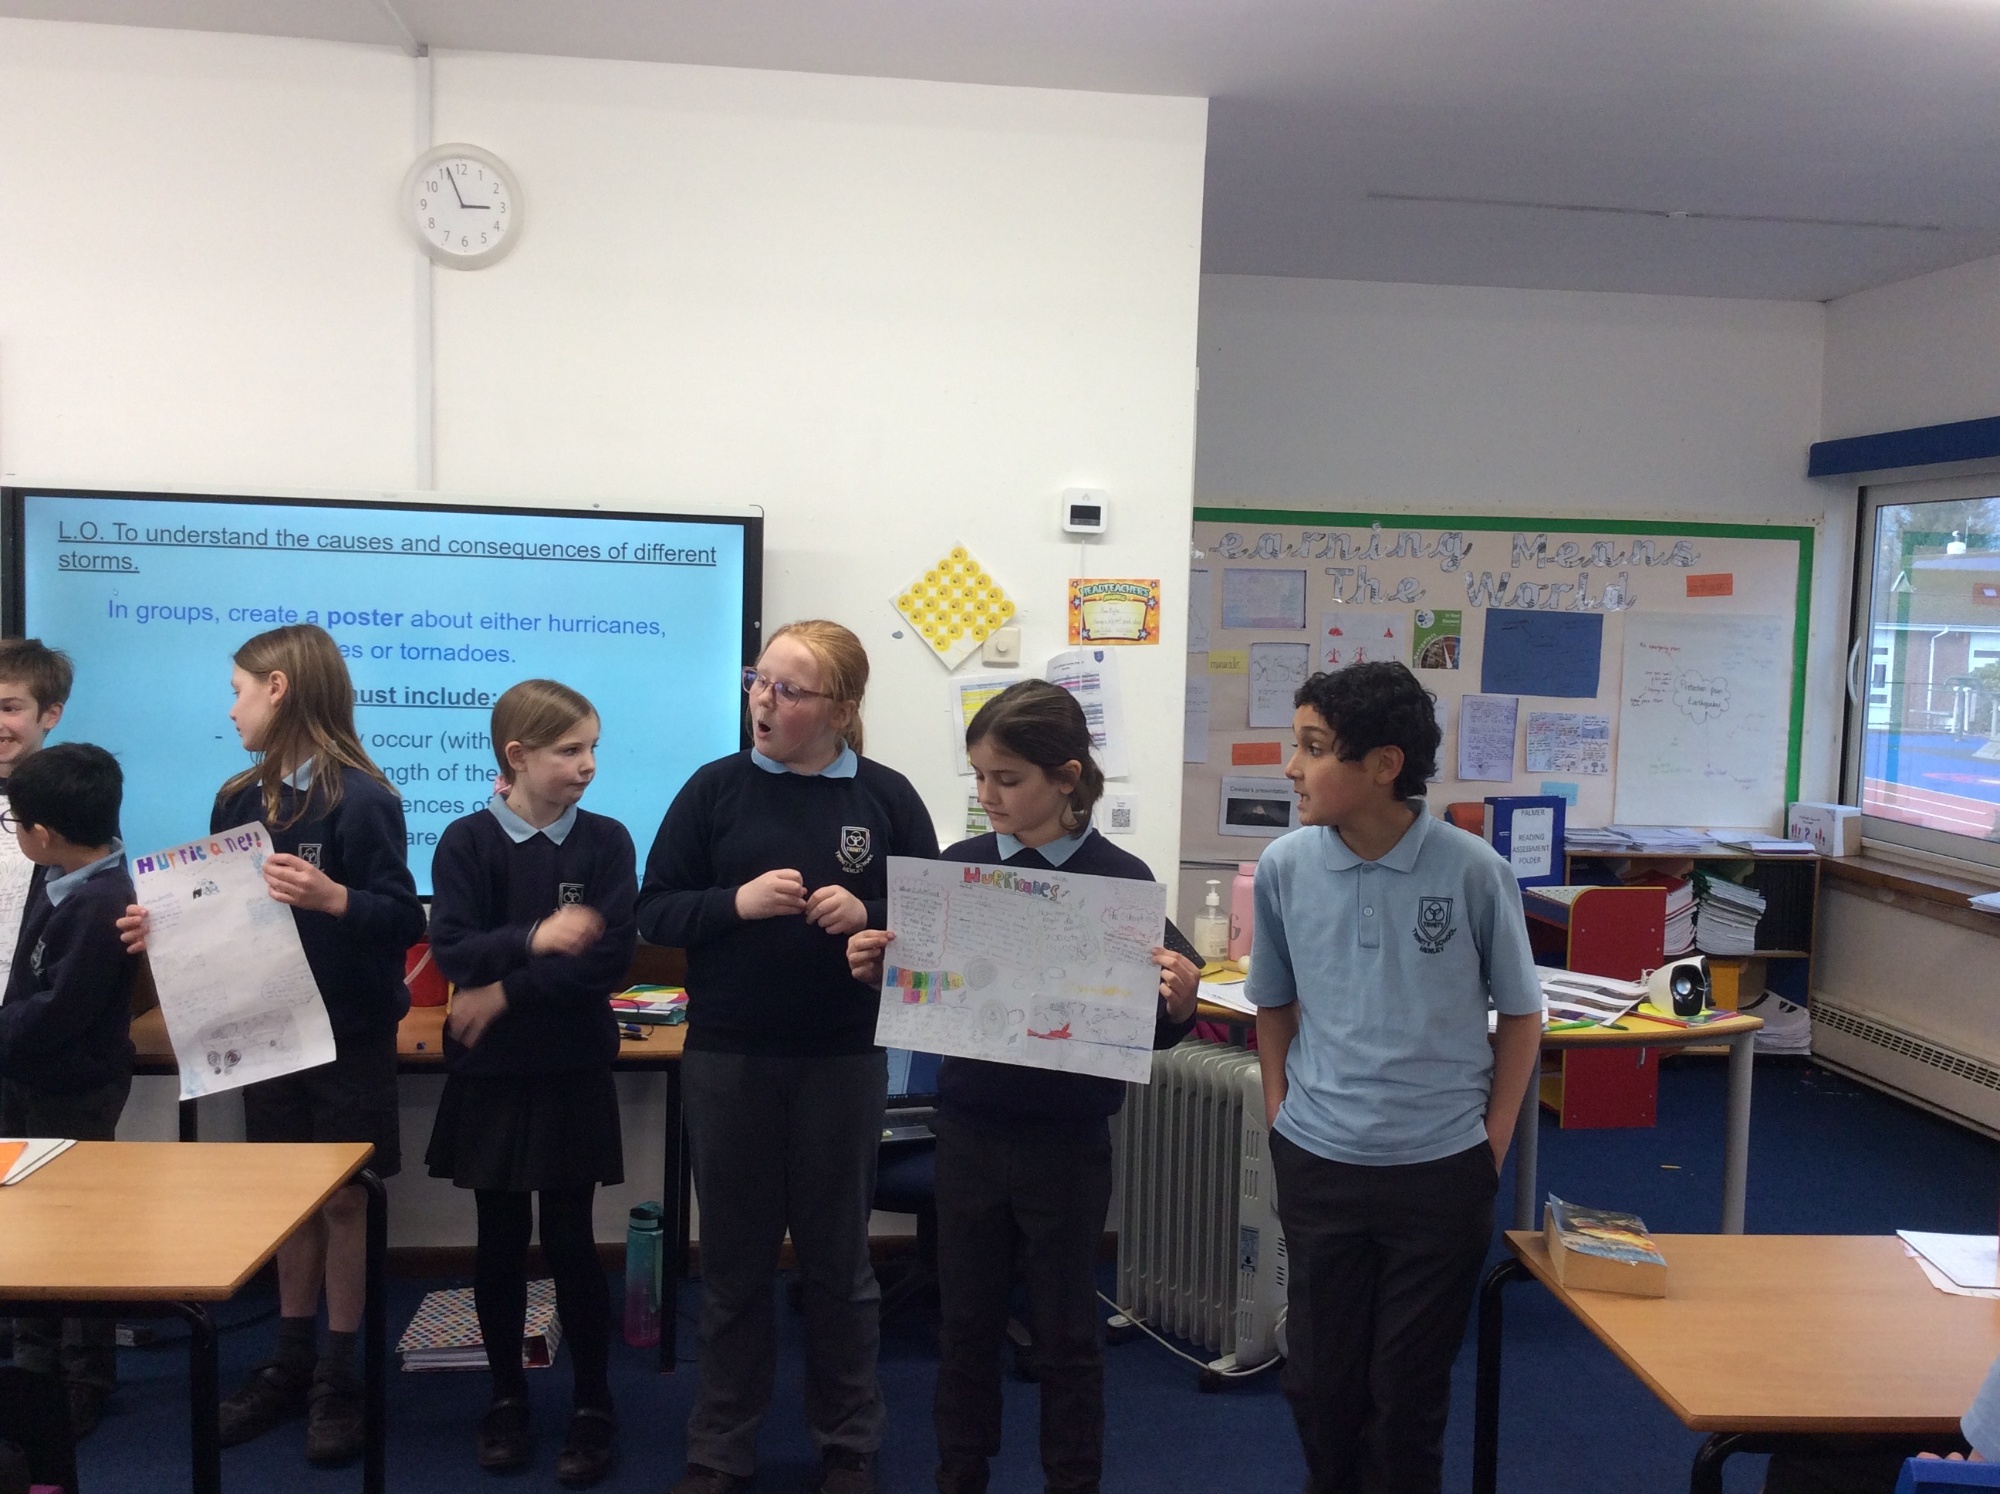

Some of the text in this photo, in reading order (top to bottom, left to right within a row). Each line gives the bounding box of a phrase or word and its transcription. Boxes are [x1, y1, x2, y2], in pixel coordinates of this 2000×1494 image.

[456, 163, 468, 176] 12
[477, 169, 483, 181] 1
[426, 181, 438, 193] 10
[492, 182, 500, 195] 2
[419, 198, 428, 211] 9
[499, 201, 506, 214] 3
[428, 217, 435, 229] 8
[493, 220, 500, 232] 4
[443, 230, 450, 242] 7
[461, 235, 469, 248] 6
[480, 232, 488, 244] 5
[59, 521, 717, 564] L.O. To understand the causes and consequences of different
[1511, 532, 1702, 570] Means
[59, 550, 139, 570] storms.
[1324, 564, 1638, 613] The World
[108, 599, 666, 639] In groups, create a poster about either hurricanes,
[370, 646, 394, 661] or
[400, 643, 517, 664] tornadoes.
[404, 687, 497, 706] include:
[371, 733, 433, 749] occur
[383, 763, 498, 785] ngth of the
[1518, 833, 1545, 841] READING
[1512, 844, 1550, 853] ASSESSMENT
[1518, 856, 1542, 865] FOLDER
[1412, 927, 1457, 947] TRINITY SCHOOL
[1419, 946, 1444, 955] HENLEY
